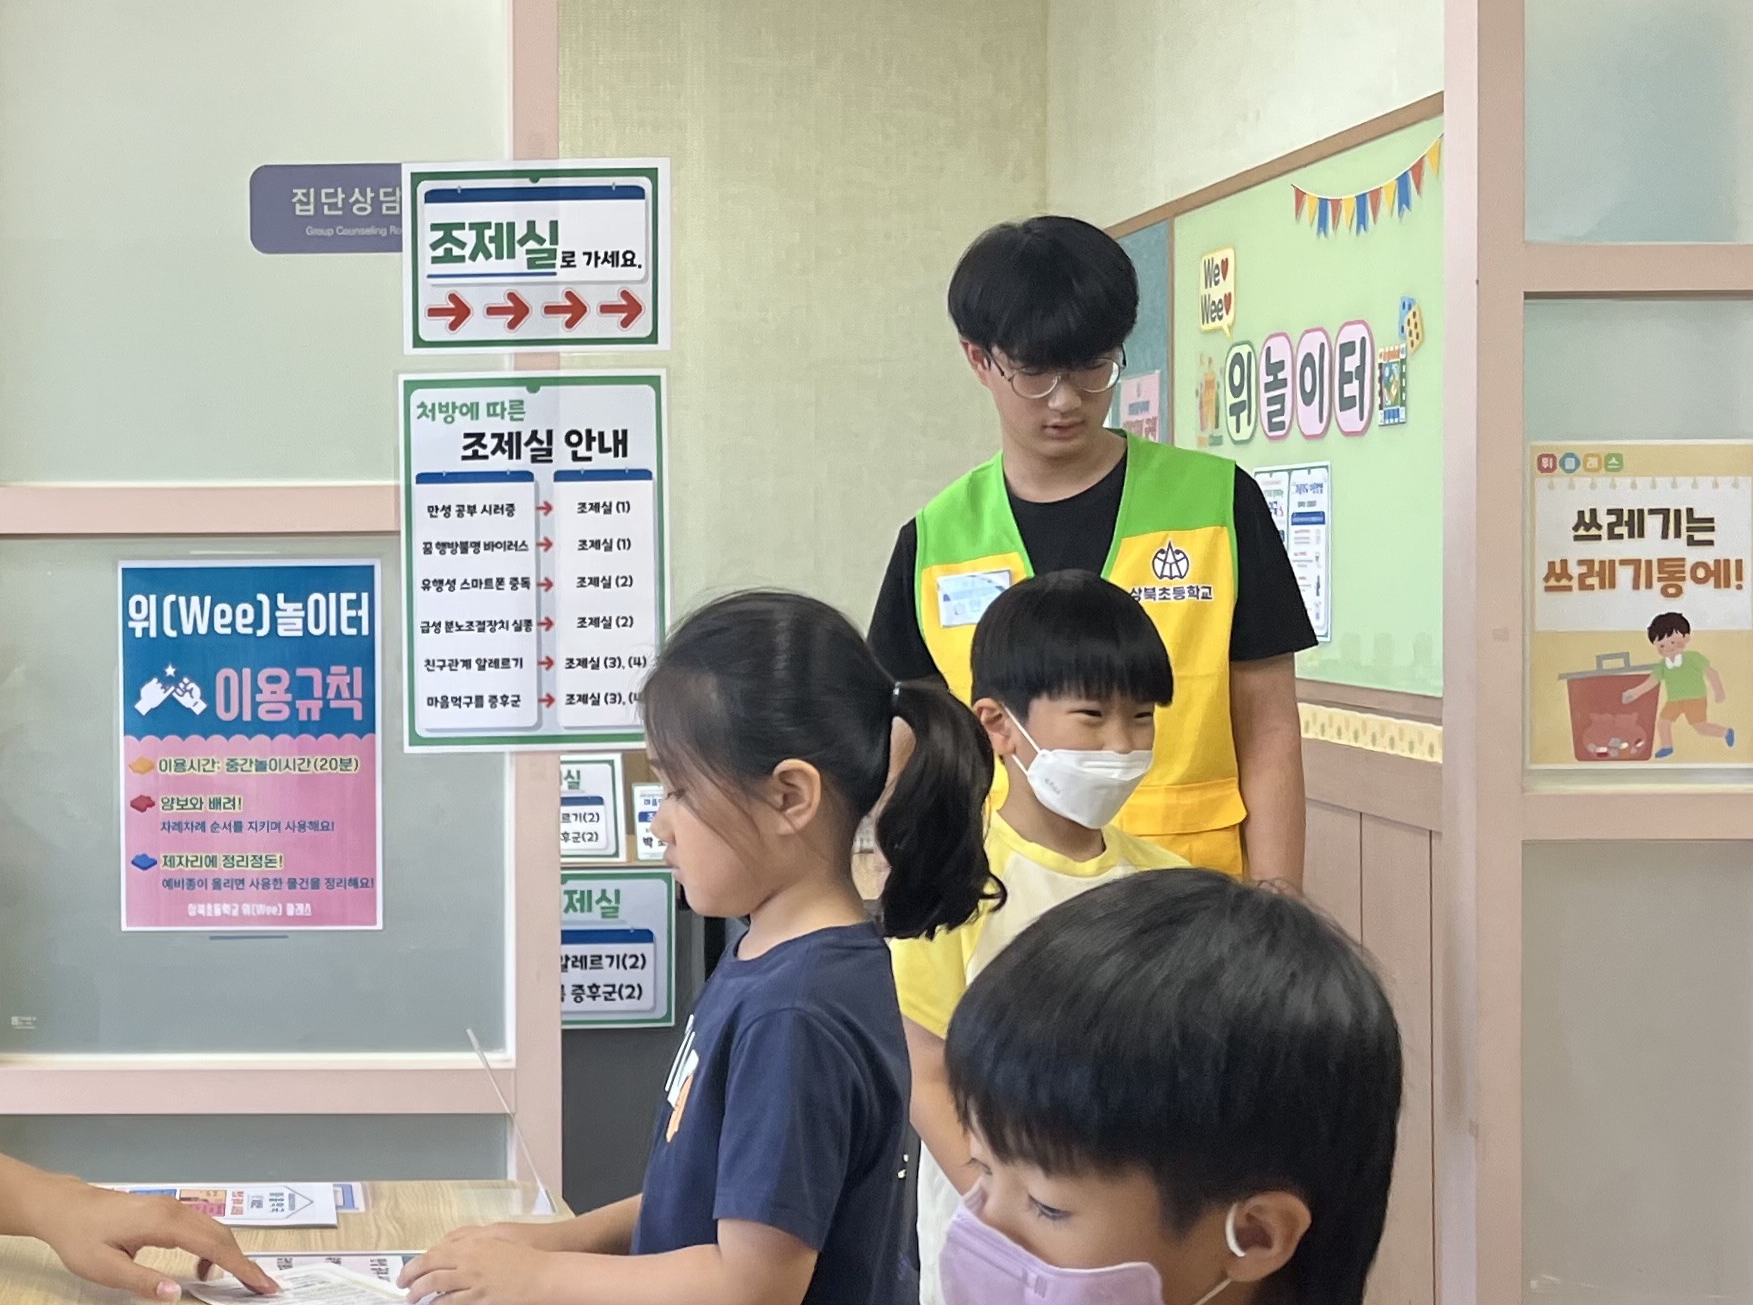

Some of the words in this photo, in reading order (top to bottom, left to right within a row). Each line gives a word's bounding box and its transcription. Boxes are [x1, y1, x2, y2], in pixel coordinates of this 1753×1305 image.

[306, 225, 334, 237] Group
[336, 225, 387, 237] Counseling
[583, 250, 642, 270] 가세요.
[1203, 258, 1221, 289] We
[1201, 295, 1224, 325] Wee
[417, 400, 479, 424] 처방에
[486, 399, 526, 421] 따른
[461, 429, 554, 463] 조제실
[565, 428, 629, 462] 안내
[427, 505, 452, 518] 만성
[455, 504, 478, 518] 공부
[577, 501, 612, 515] 조제실
[616, 501, 630, 513] (1)
[1572, 507, 1715, 546] 쓰레기는
[578, 538, 612, 552] 조제실
[617, 538, 631, 551] (1)
[421, 578, 455, 592] 유행성
[576, 576, 612, 590] 조제실
[615, 576, 633, 588] (2)
[1543, 558, 1744, 598] 쓰레기통에!
[1130, 584, 1213, 601] 상북초등학교
[420, 620, 442, 634] 급성
[577, 616, 612, 630] 조제실
[615, 616, 634, 628] (2)
[424, 657, 472, 672] 친구관계
[475, 657, 523, 671] 알레르기
[565, 655, 600, 670] 조제실
[604, 656, 625, 670] (3),
[216, 666, 363, 721] 이용규칙
[565, 692, 600, 707] 조제실
[604, 692, 625, 706] (3),
[158, 758, 221, 773] 이용시간:
[161, 797, 204, 811] 양보와
[209, 797, 242, 811] 배려!
[160, 820, 207, 833] 차례차례
[247, 820, 282, 833] 지키며
[285, 820, 335, 833] 사용해요!
[162, 854, 218, 869] 제자리에
[222, 854, 283, 869] 정리정돈!
[249, 878, 283, 890] 사용한
[325, 878, 374, 890] 정리해요!
